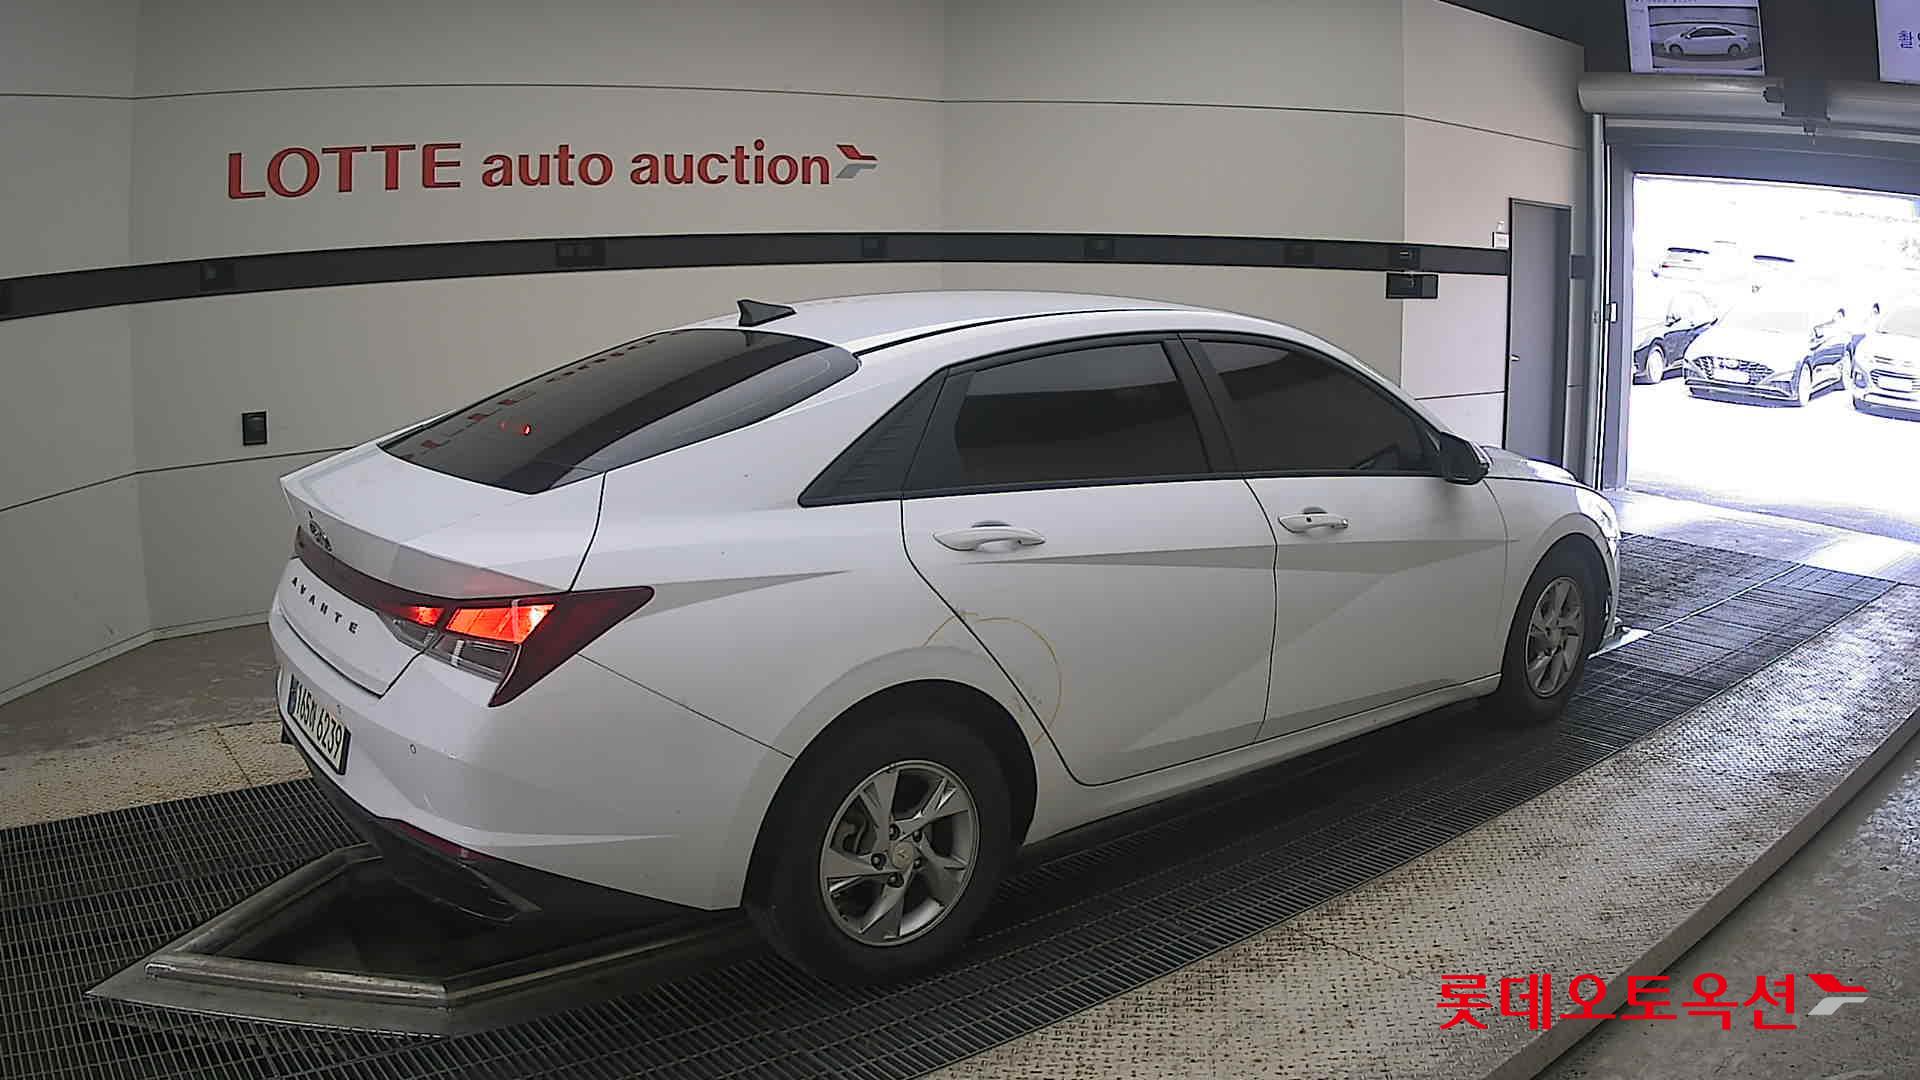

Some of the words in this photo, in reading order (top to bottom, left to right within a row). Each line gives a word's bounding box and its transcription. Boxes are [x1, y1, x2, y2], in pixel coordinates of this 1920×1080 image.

[229, 143, 462, 200] LOTTE
[481, 144, 613, 188] auto
[630, 139, 831, 186] auction
[291, 576, 359, 635] AVANTE
